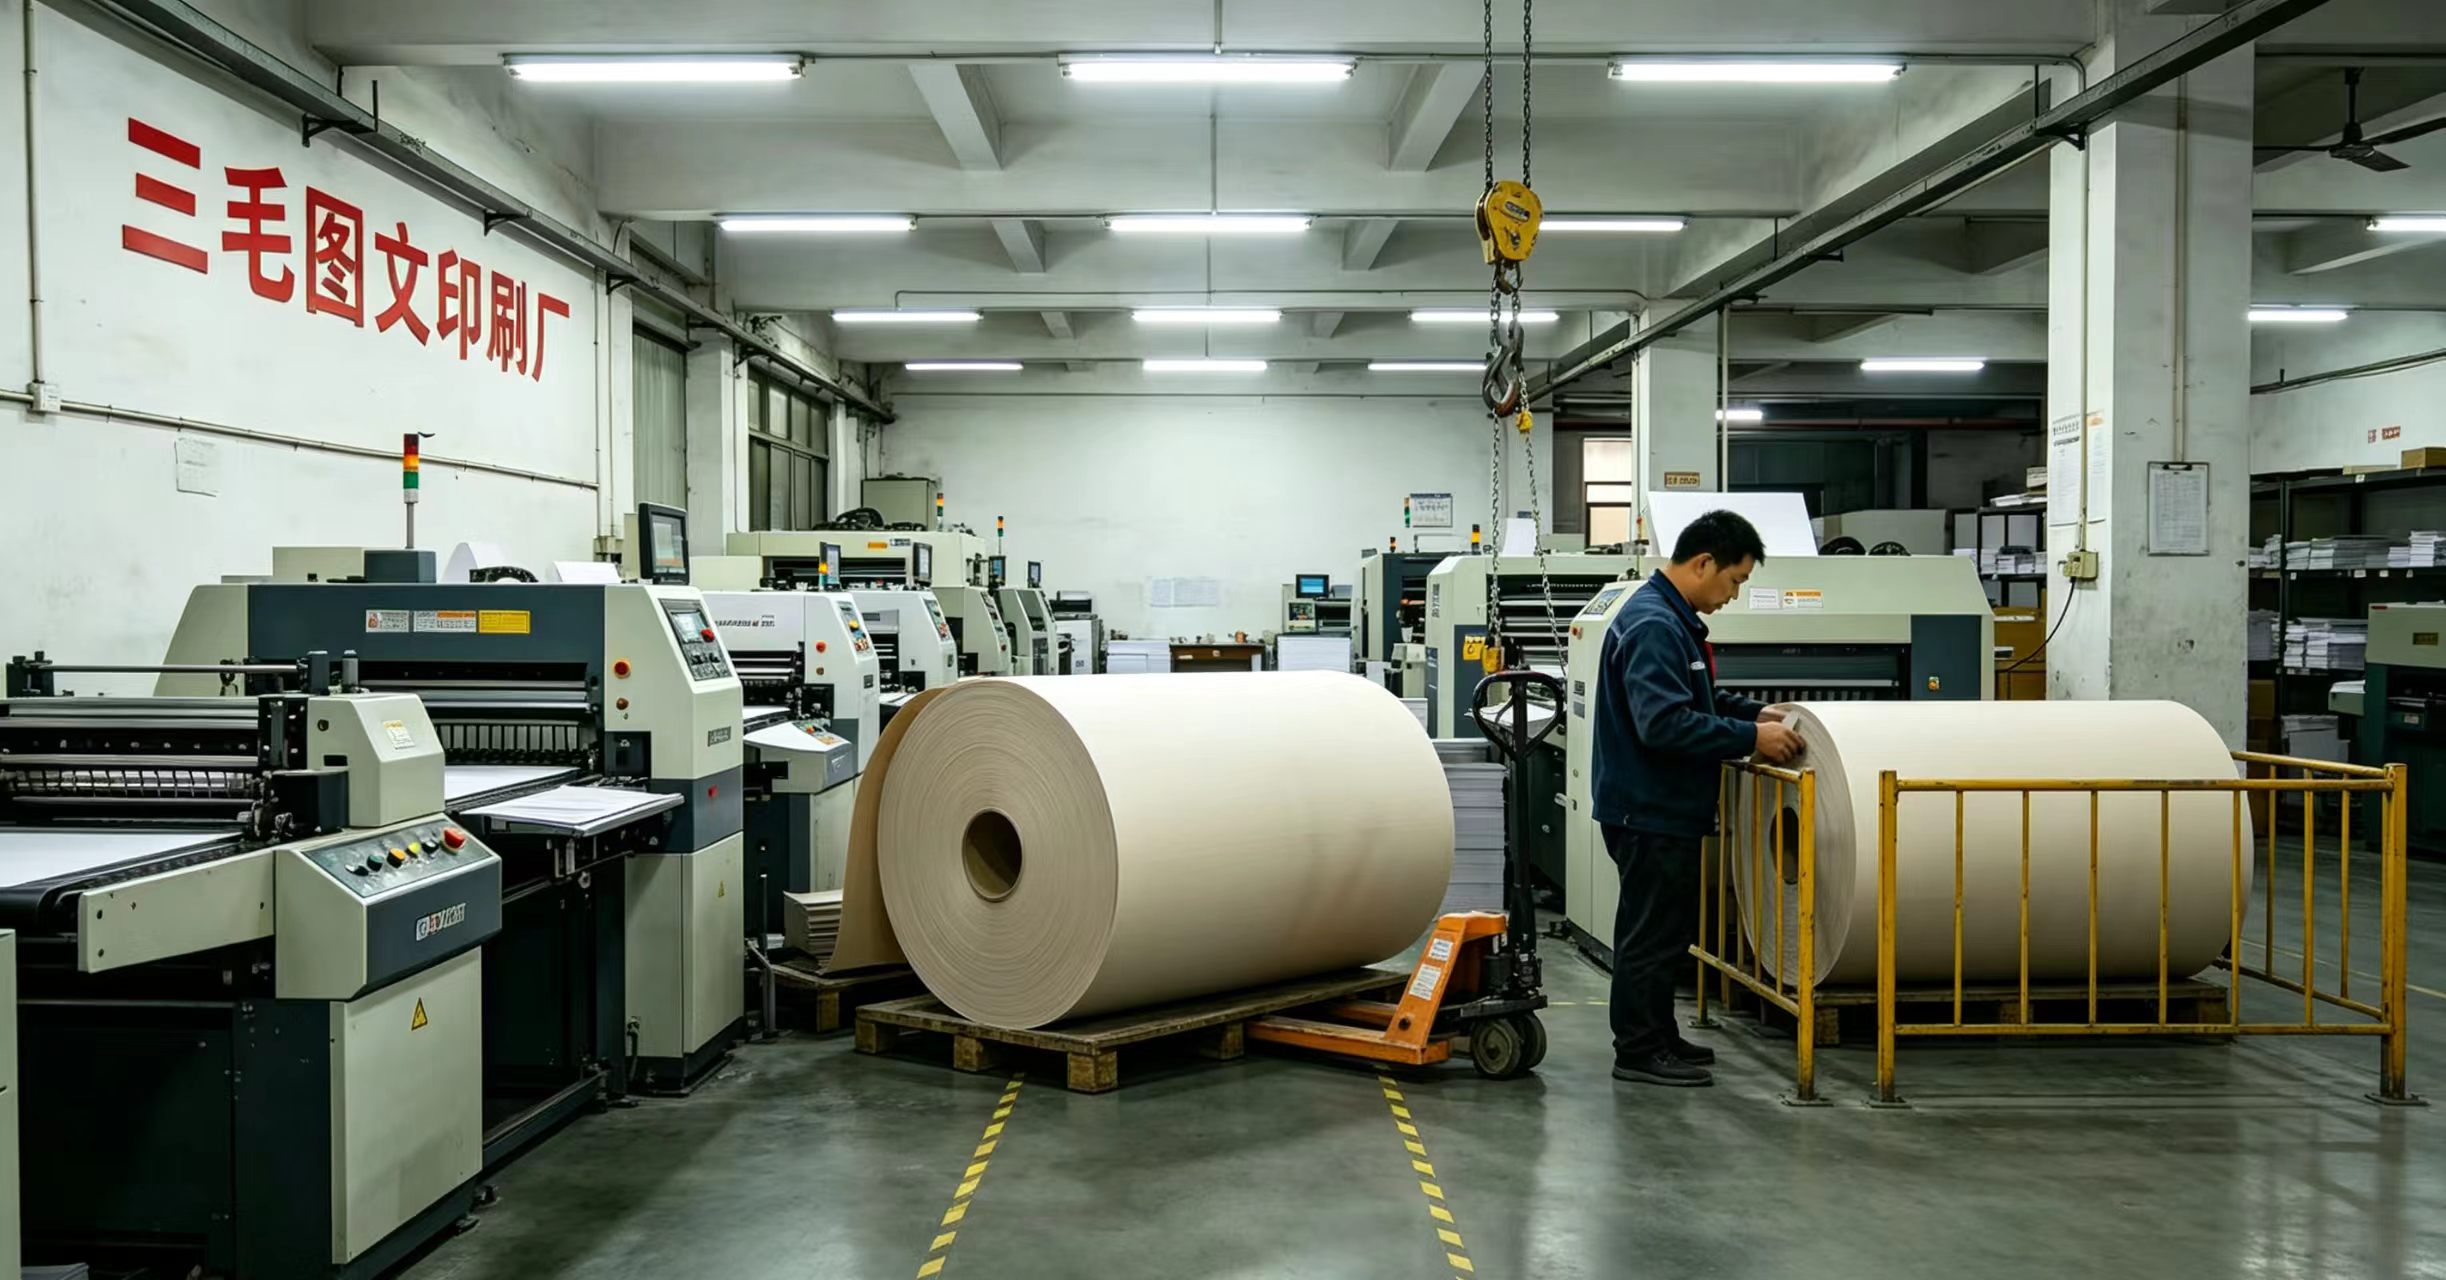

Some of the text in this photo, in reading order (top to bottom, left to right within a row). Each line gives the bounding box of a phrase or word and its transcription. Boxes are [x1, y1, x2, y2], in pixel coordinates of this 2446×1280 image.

[122, 117, 569, 382] 三毛图文印刷厂
